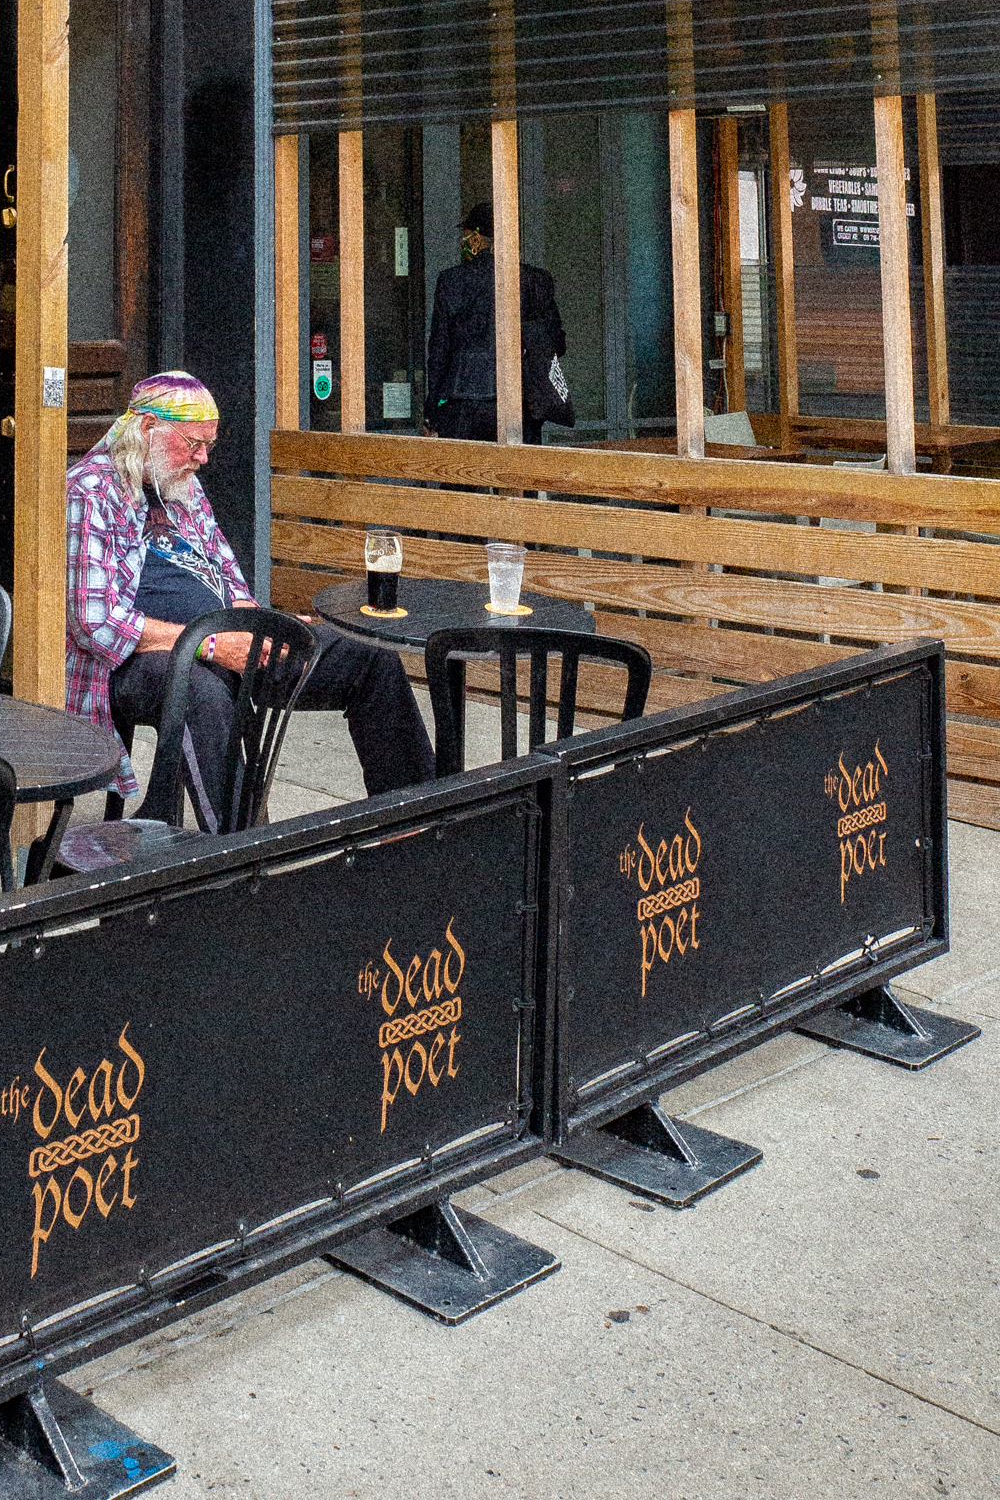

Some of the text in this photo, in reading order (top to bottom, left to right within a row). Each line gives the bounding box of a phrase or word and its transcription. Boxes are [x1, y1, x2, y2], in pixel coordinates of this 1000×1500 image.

[619, 806, 701, 891] the dead
[358, 916, 465, 1016] the dead
[639, 902, 700, 997] poet
[1, 1021, 145, 1139] the dead
[380, 1025, 461, 1134] poet
[31, 1146, 139, 1280] poet
